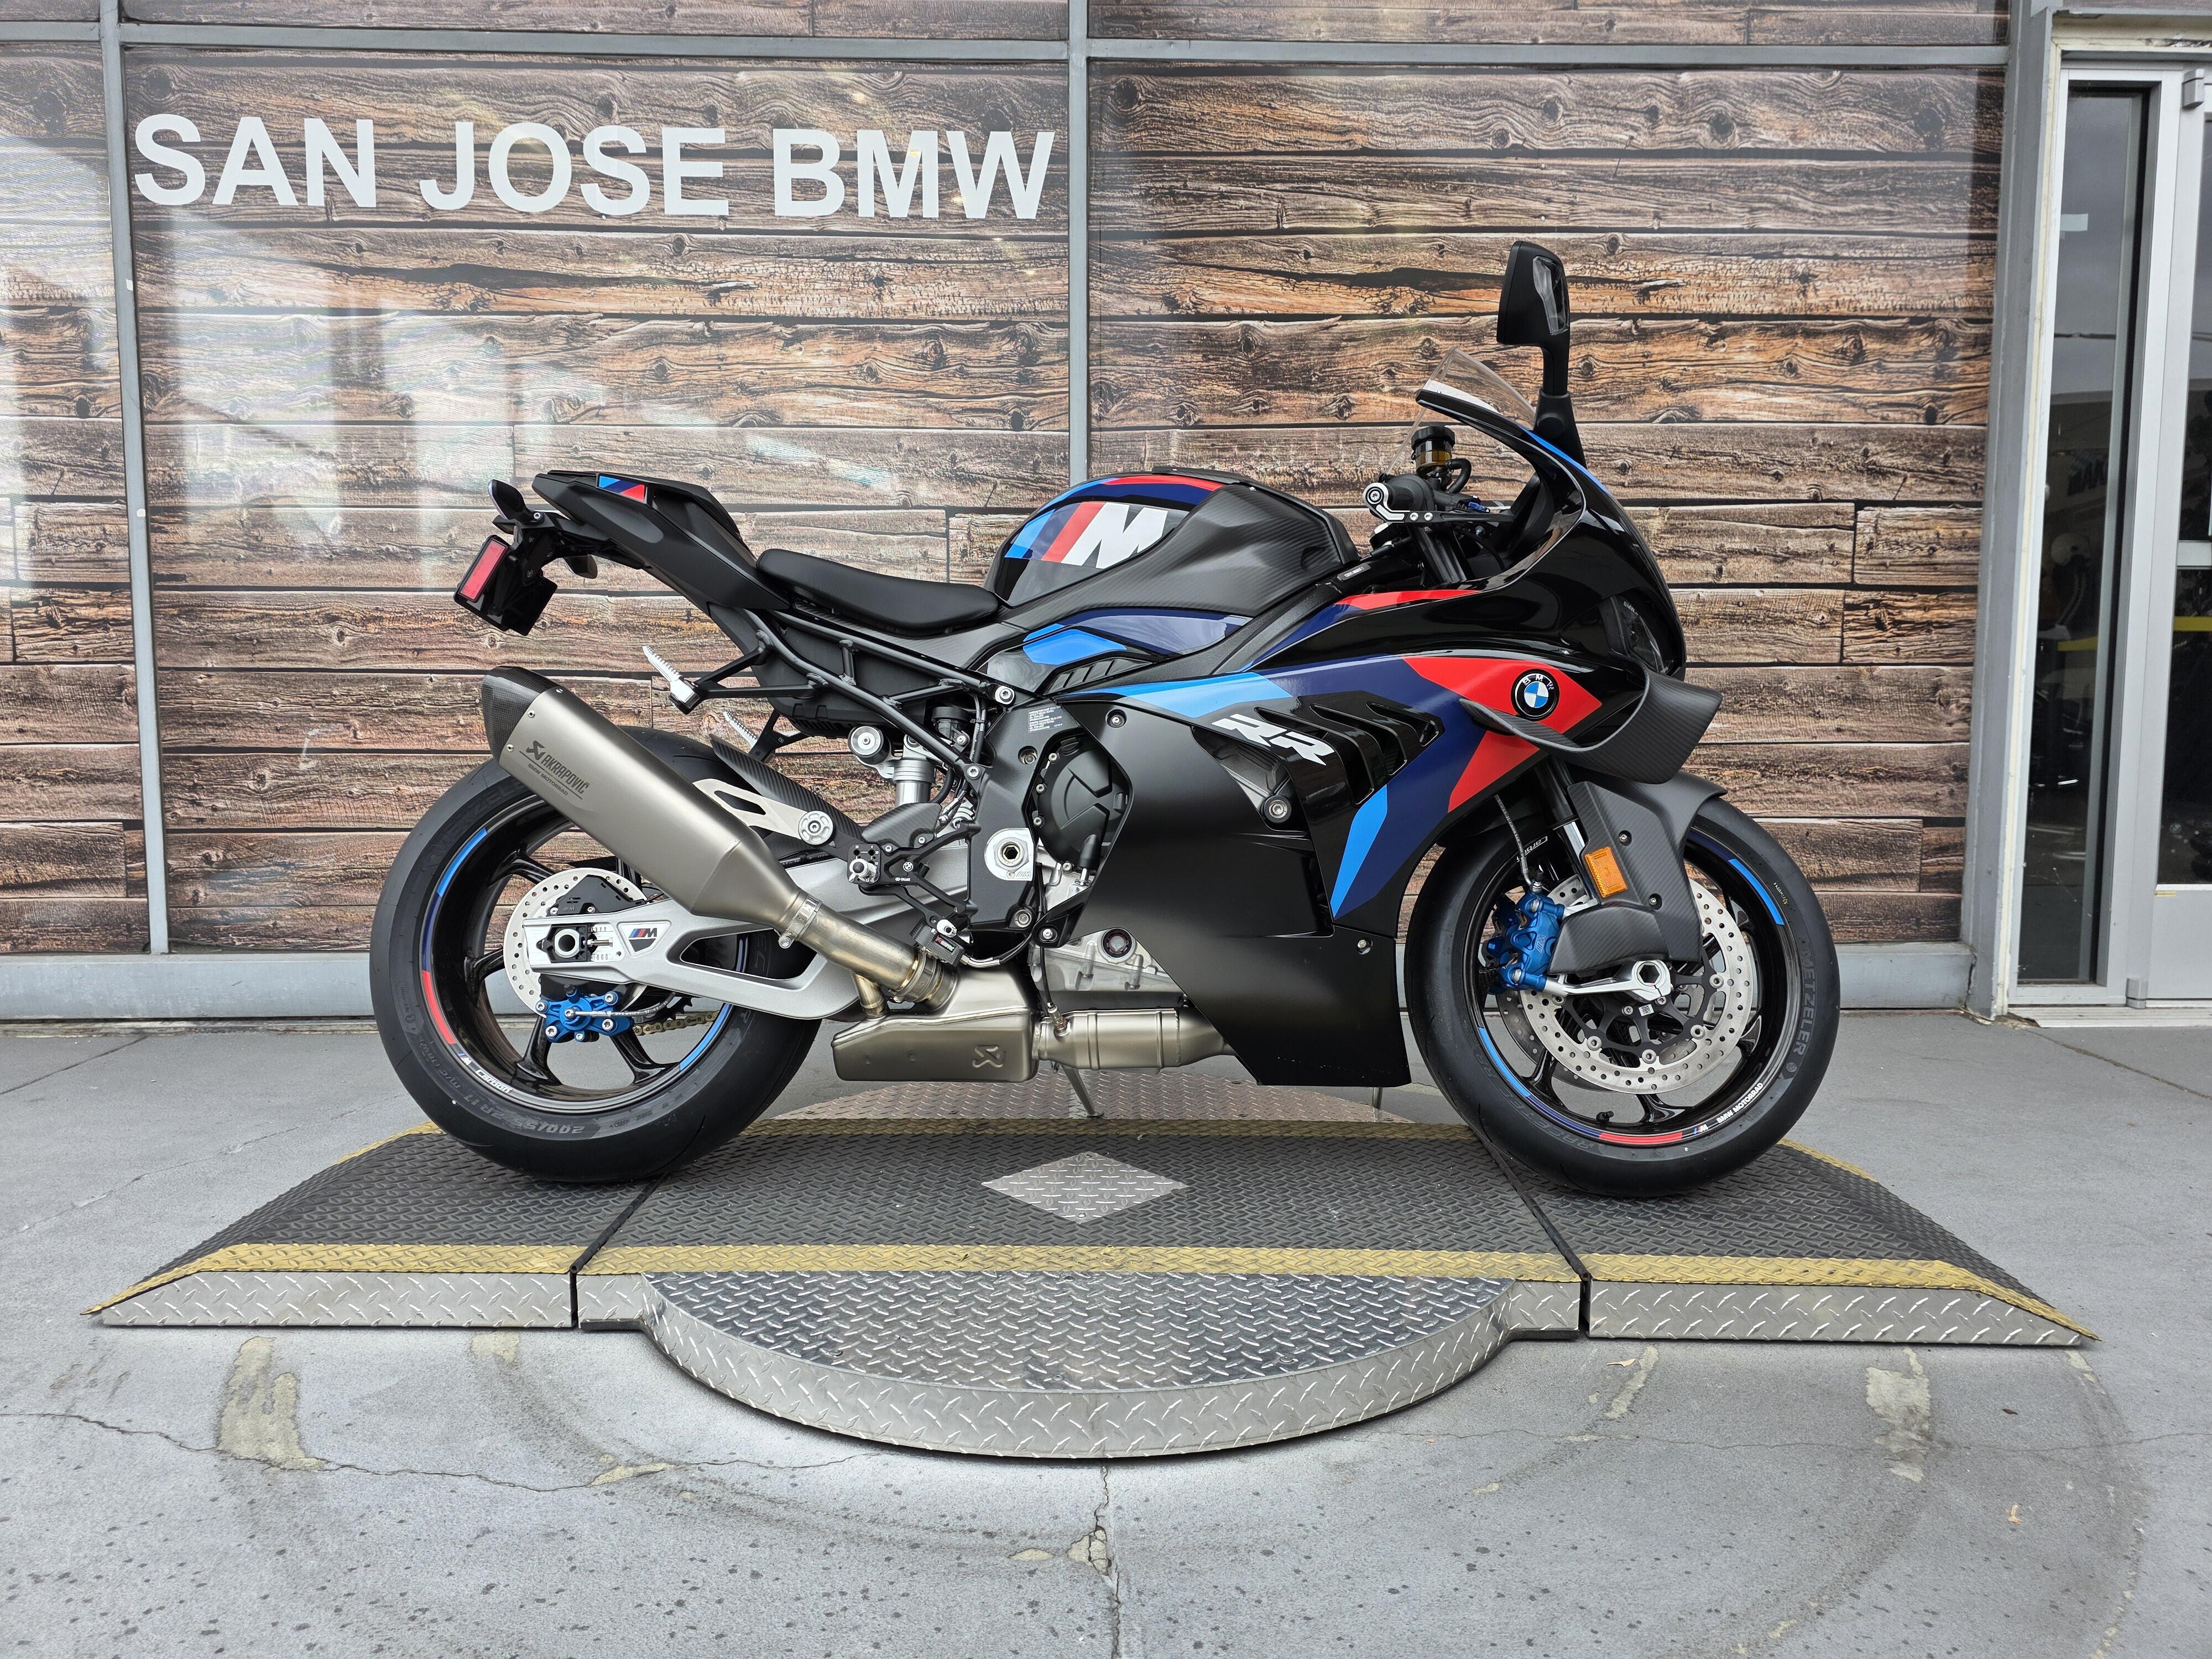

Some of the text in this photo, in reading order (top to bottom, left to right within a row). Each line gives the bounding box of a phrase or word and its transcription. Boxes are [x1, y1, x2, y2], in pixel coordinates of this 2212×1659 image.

[134, 113, 1055, 220] SAN JOSE BMW
[1060, 502, 1168, 569] M
[1522, 674, 1554, 691] BMW
[1211, 713, 1335, 766] RR
[527, 763, 568, 796] BMW MOTORRAD
[1792, 950, 1816, 1056] METZELER
[476, 1069, 513, 1093] Carbon
[480, 1104, 507, 1120] ZR
[1716, 1109, 1734, 1124] BMW
[1732, 1082, 1764, 1113] MOTORRAD
